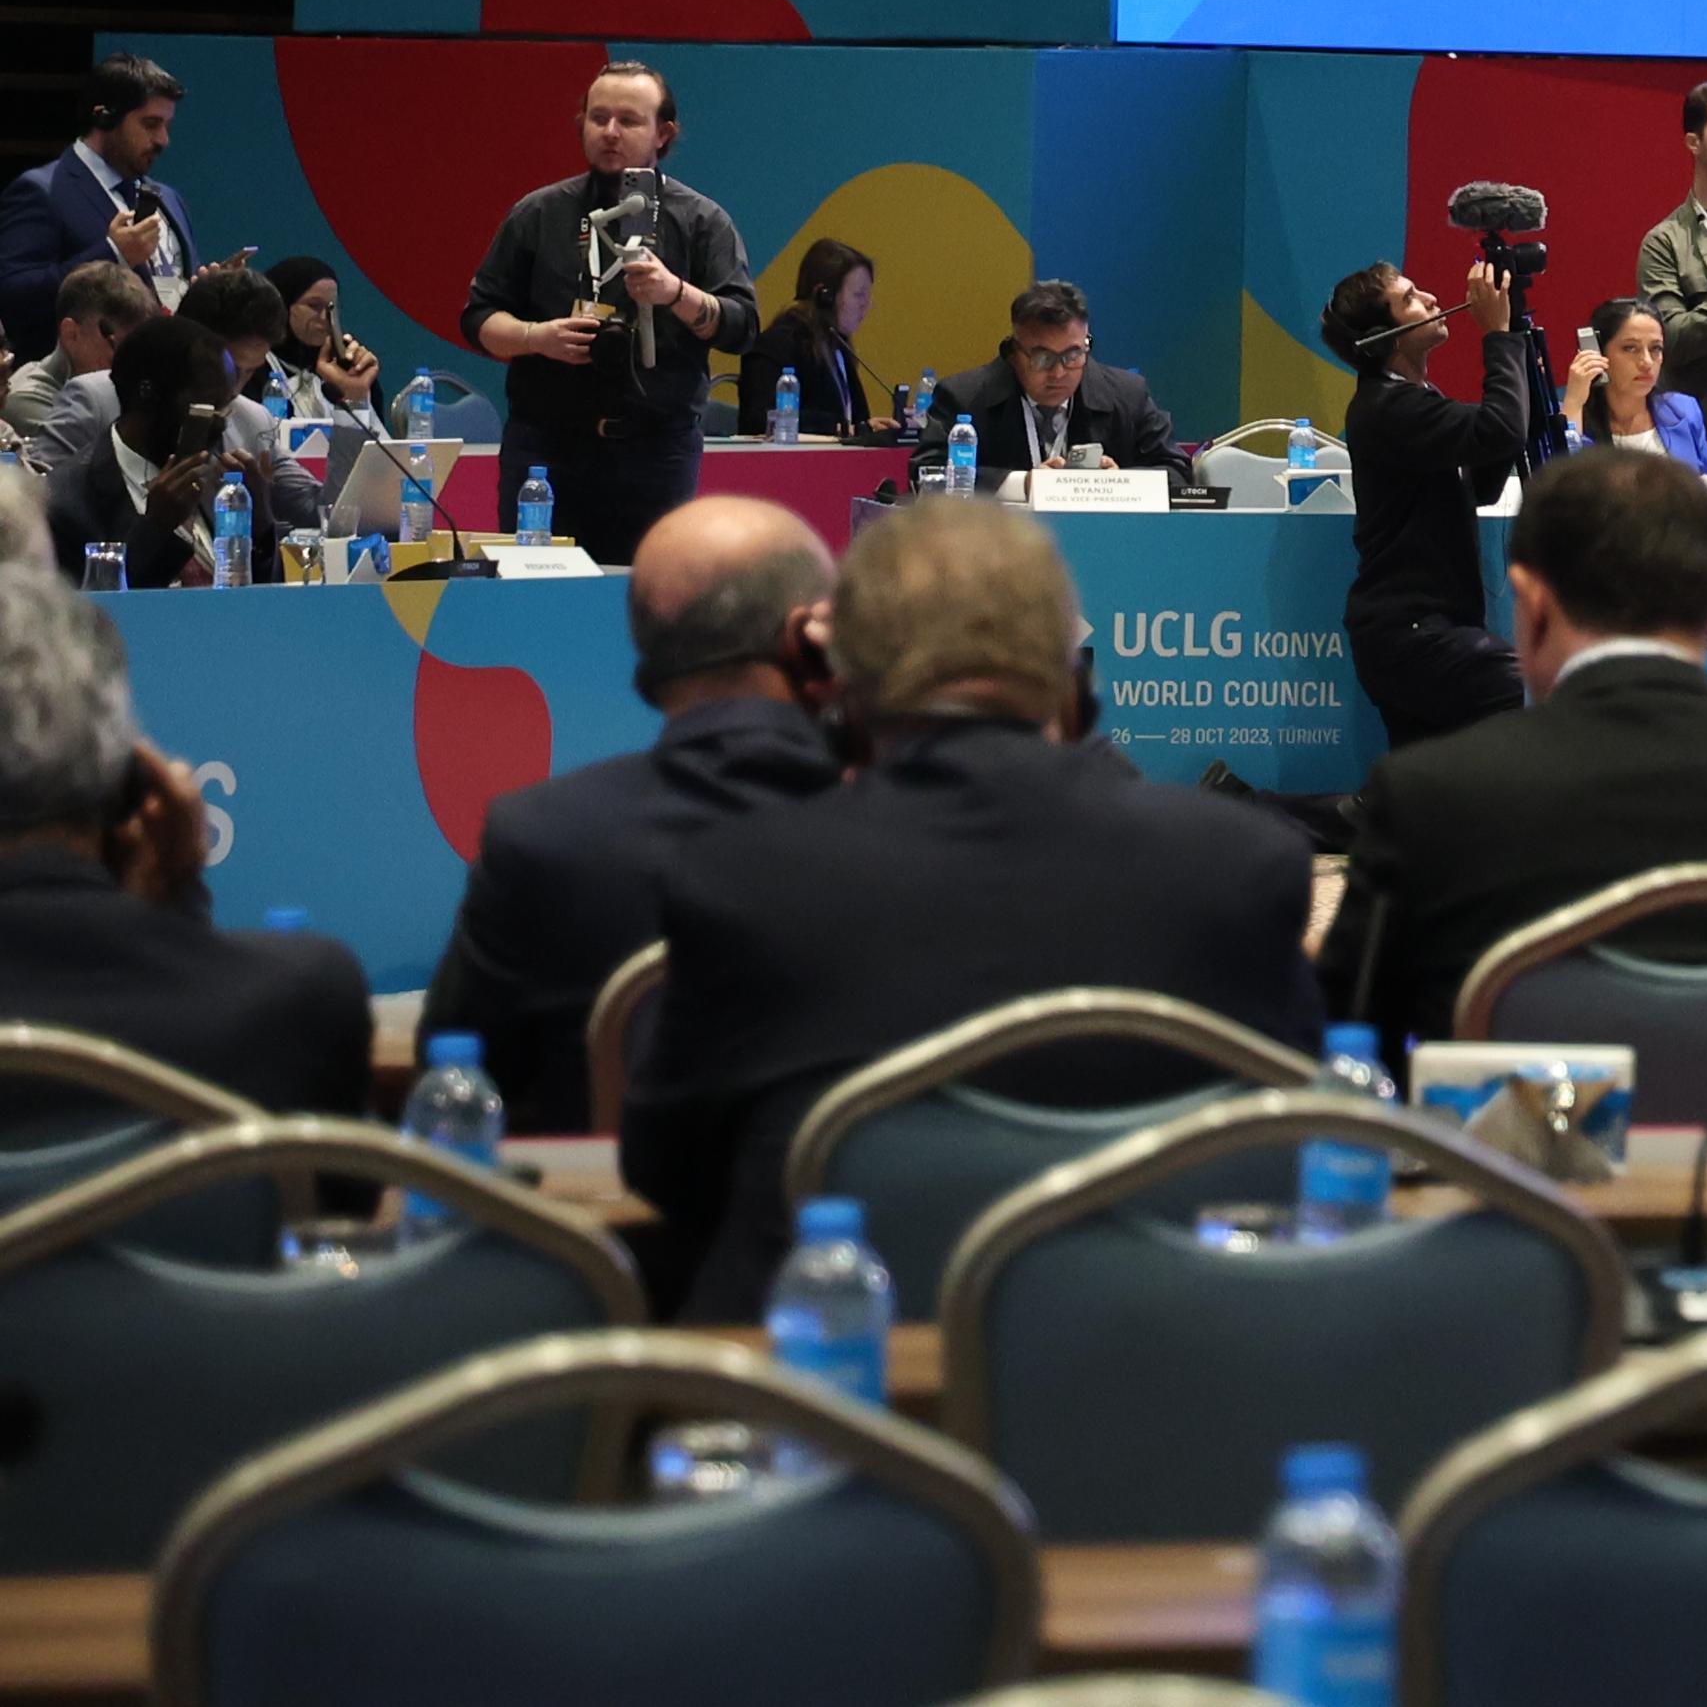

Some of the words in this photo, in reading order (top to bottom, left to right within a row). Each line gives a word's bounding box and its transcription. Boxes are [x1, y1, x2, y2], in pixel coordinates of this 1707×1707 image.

[1056, 476, 1089, 484] ASHOK
[1094, 476, 1130, 484] KUMAR
[1114, 611, 1241, 657] UCLG
[1254, 632, 1342, 657] KONYA
[1113, 681, 1212, 706] WORLD
[1224, 681, 1341, 707] COUNCIL
[1112, 728, 1130, 744] 26
[1170, 728, 1191, 744] 28
[1196, 728, 1224, 744] OCT
[1229, 728, 1272, 745] 2023,
